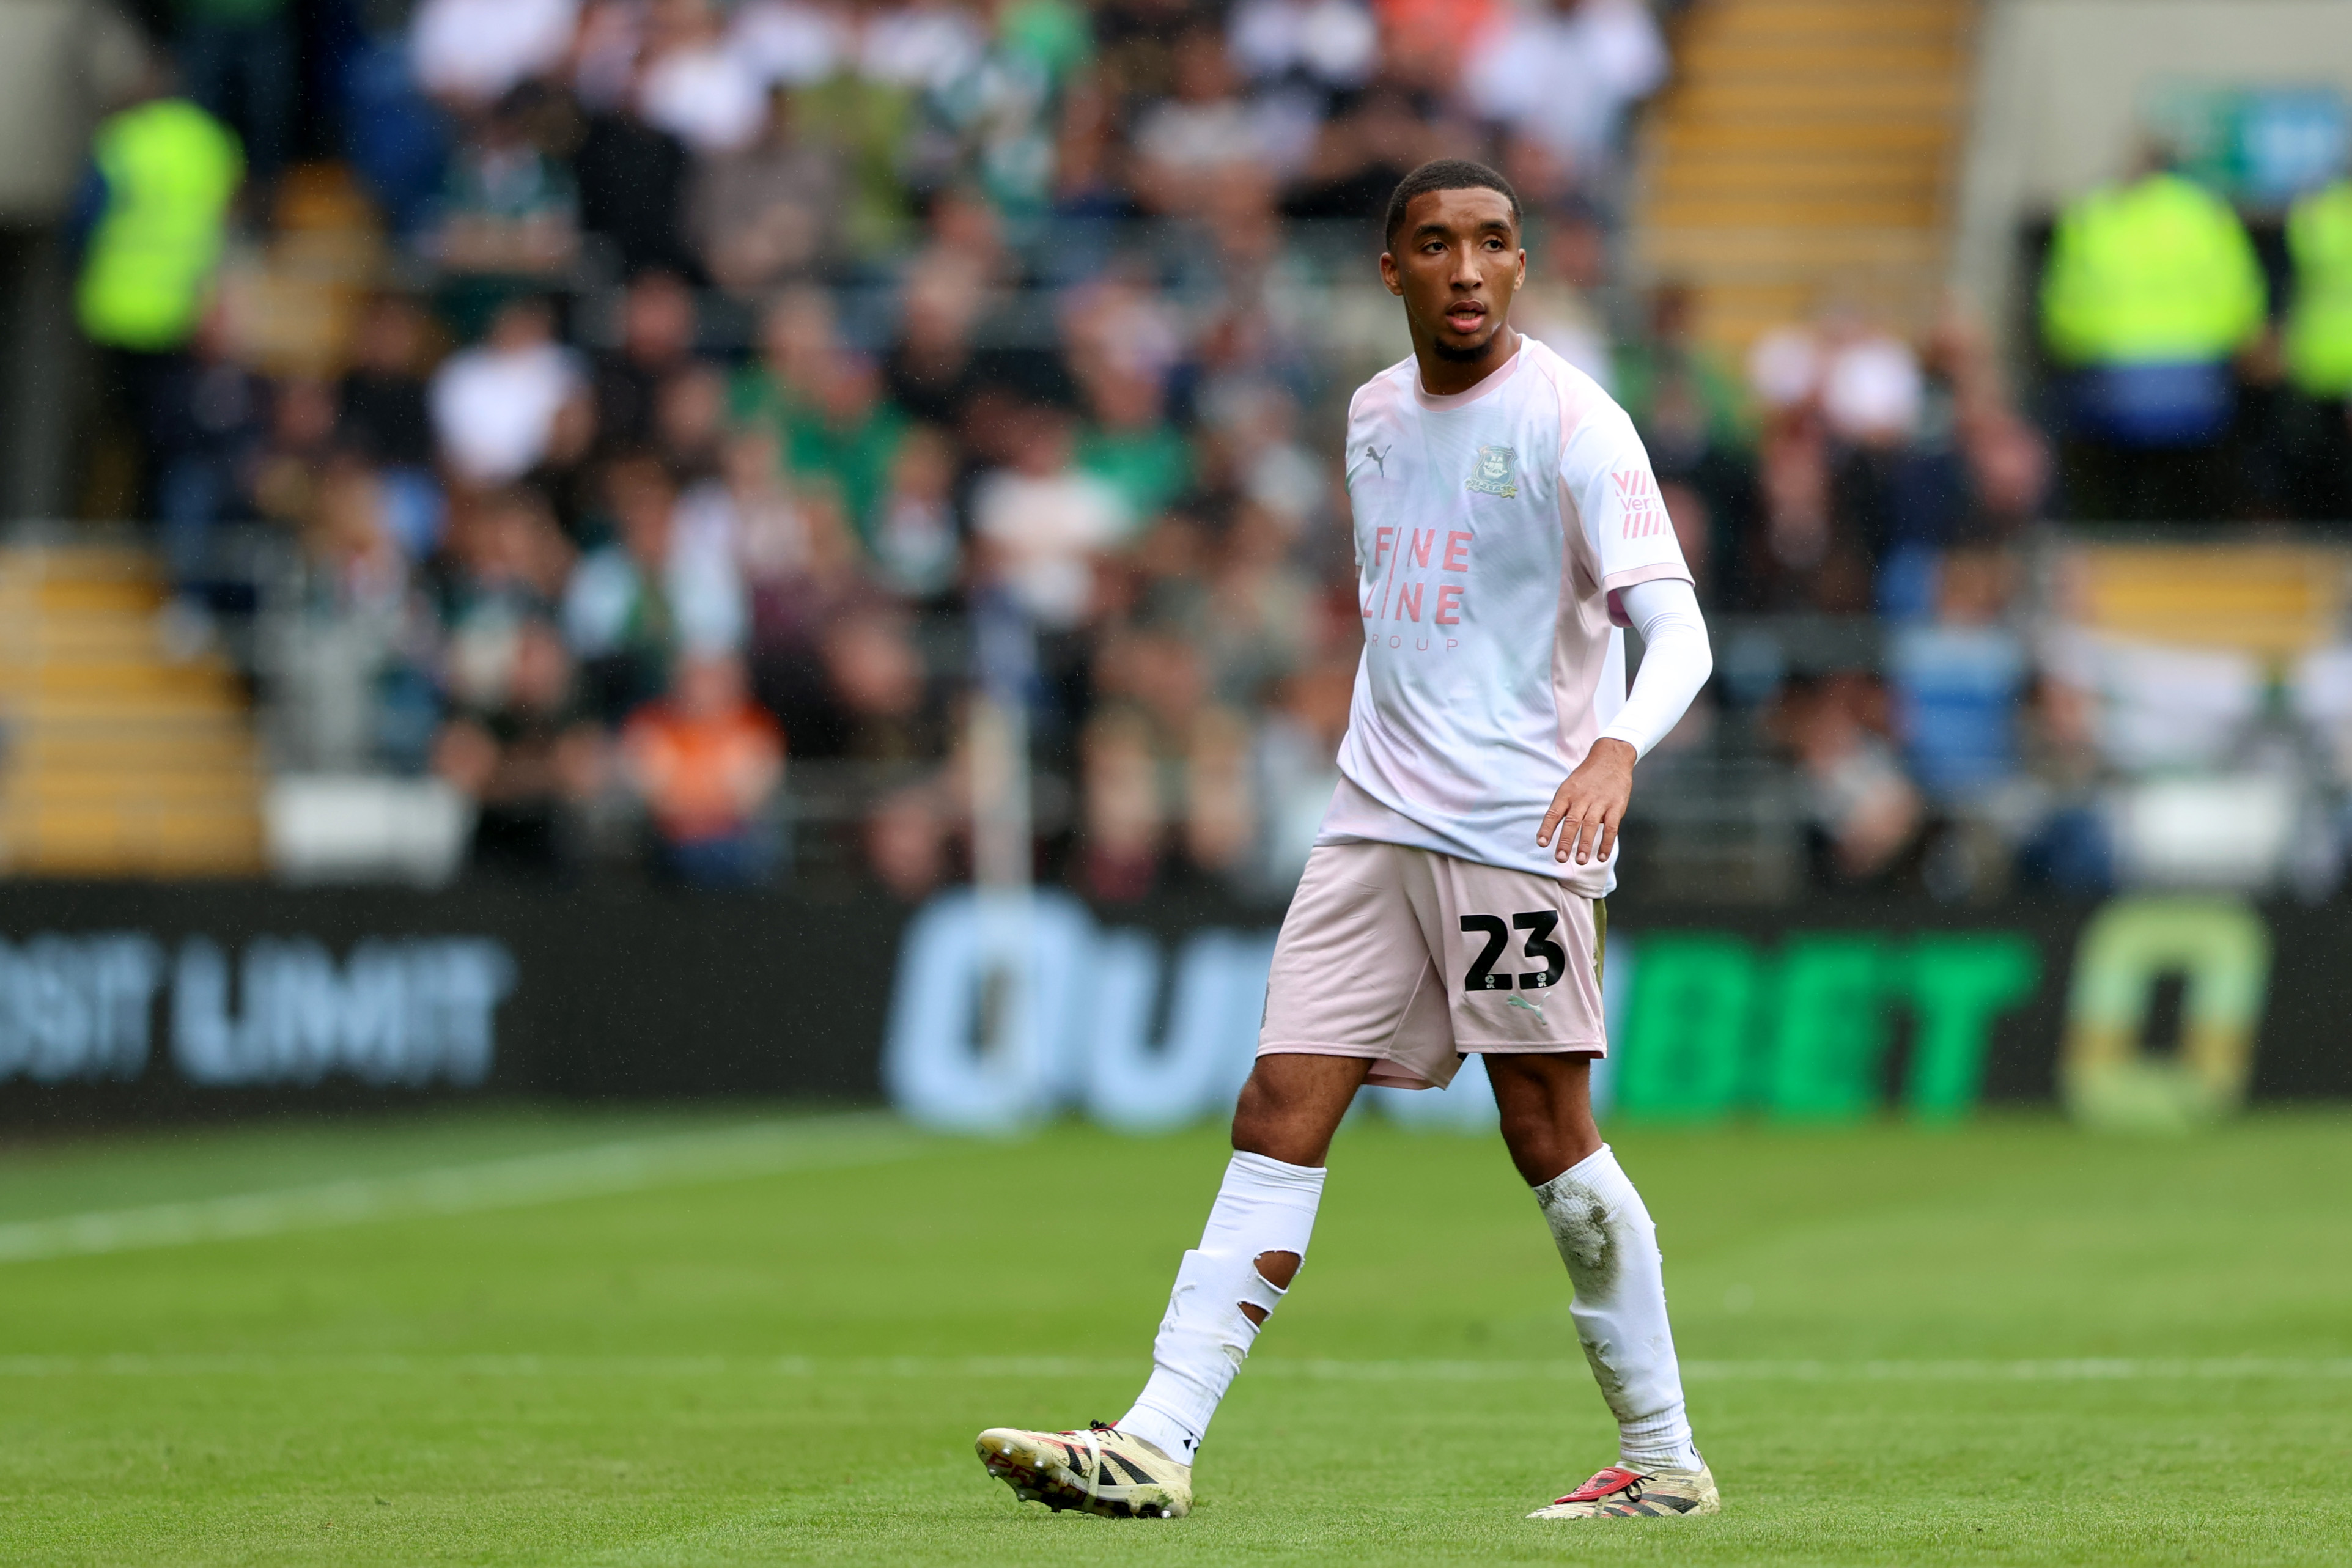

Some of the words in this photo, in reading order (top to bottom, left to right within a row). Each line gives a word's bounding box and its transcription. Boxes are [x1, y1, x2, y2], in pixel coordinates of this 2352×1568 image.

[1620, 496, 1663, 512] Vert
[1375, 526, 1473, 572] FINE
[1362, 581, 1465, 625] LINE
[1371, 633, 1459, 652] ROUP
[1460, 910, 1565, 992] 23
